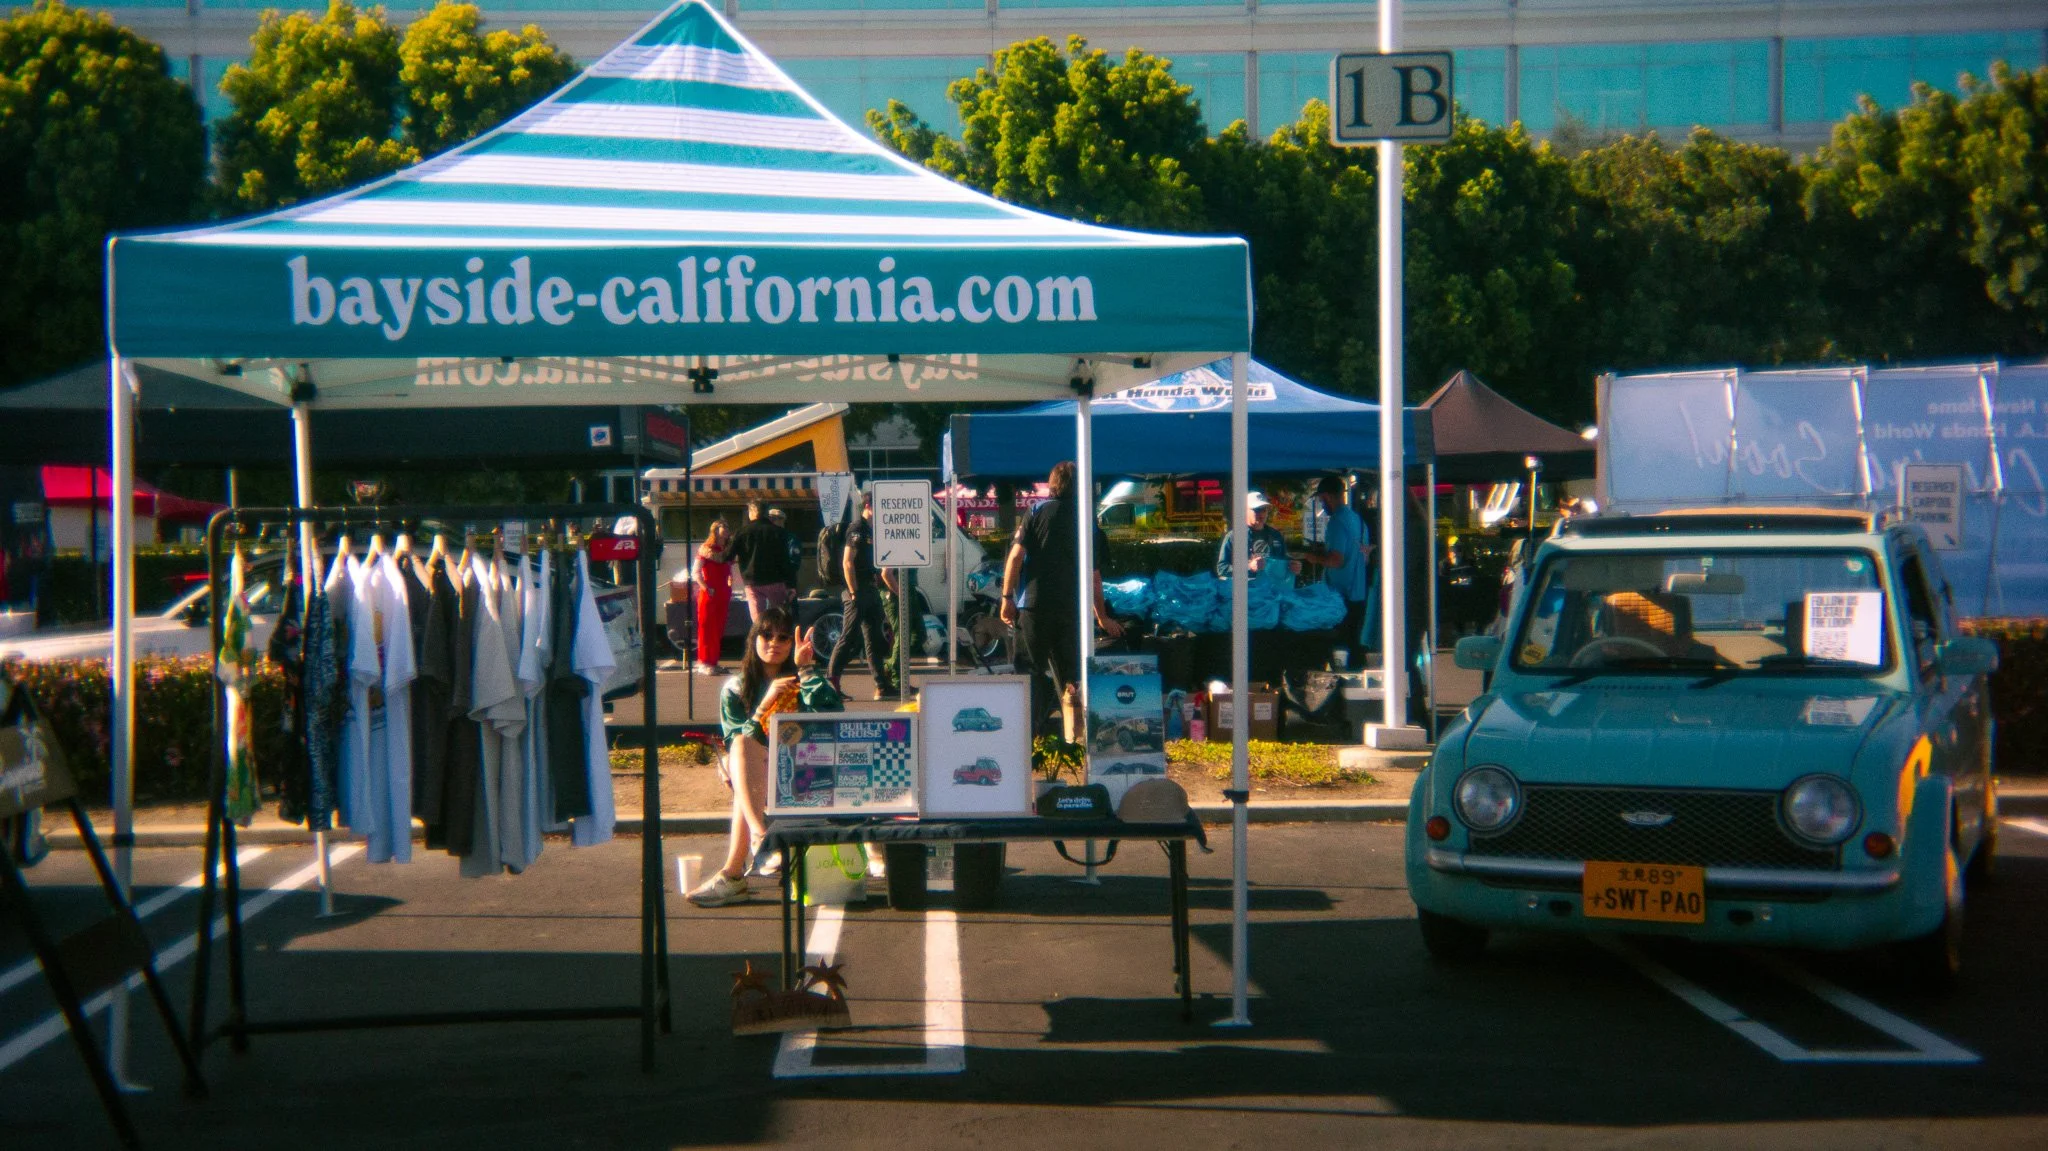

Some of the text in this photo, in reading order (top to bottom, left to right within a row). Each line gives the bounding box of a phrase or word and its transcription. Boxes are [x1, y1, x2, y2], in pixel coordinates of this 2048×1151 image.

[1345, 65, 1448, 128] 1 B
[287, 253, 1099, 341] bayside-california.com
[1127, 386, 1196, 398] Honda
[1201, 386, 1268, 398] Wold
[881, 498, 923, 509] RESERVED
[883, 513, 922, 525] CARPOOL
[885, 528, 921, 540] PARKING
[840, 721, 892, 731] BUILT TO
[840, 729, 882, 739] CRUISE
